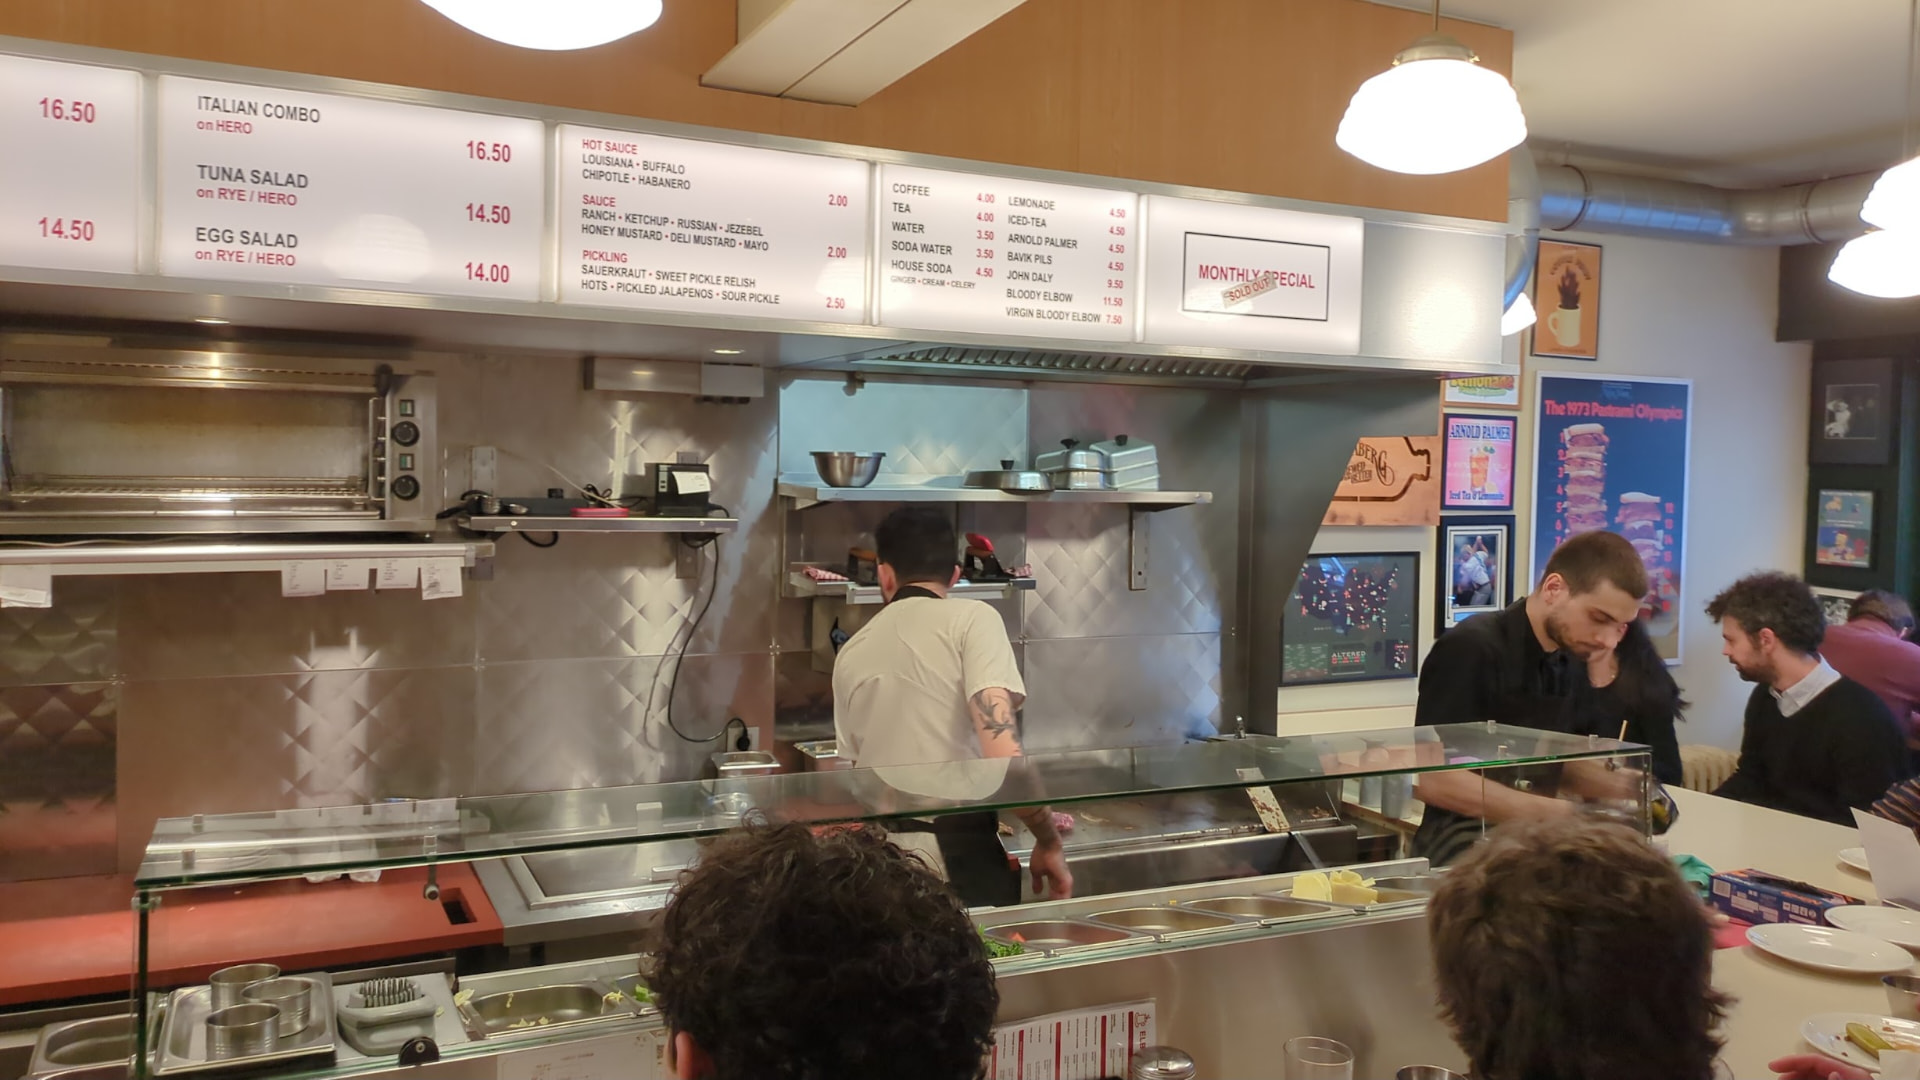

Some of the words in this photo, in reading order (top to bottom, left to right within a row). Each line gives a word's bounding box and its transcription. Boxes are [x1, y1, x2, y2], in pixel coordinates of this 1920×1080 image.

[40, 98, 95, 123] 16.50
[198, 96, 258, 116] ITALIAN
[263, 104, 320, 123] COMBO
[196, 121, 213, 130] on
[216, 120, 252, 134] HERO
[467, 141, 510, 162] 16.50
[582, 139, 603, 152] HOT
[605, 142, 637, 154] SAUCE
[583, 154, 634, 168] LOUISIANA
[642, 160, 685, 174] BUFFALO
[197, 165, 246, 182] TUNA
[250, 170, 308, 188] SALAD
[582, 169, 629, 183] CHIPOTLE
[638, 176, 690, 190] HABANERO
[893, 183, 929, 196] COFFEE
[196, 189, 214, 198] on
[218, 188, 246, 201] RYE
[258, 192, 297, 206] HERO
[582, 194, 616, 207] SAUCE
[829, 194, 848, 207] 2.00
[977, 193, 994, 204] 4.00
[1009, 197, 1054, 210] LEMONADE
[466, 203, 510, 224] 14.50
[893, 202, 911, 213] TEA
[1110, 208, 1126, 218] 4.50
[582, 209, 616, 221] RANCH
[625, 213, 669, 226] KETCHUP
[678, 218, 717, 231] RUSSIAN
[725, 224, 763, 236] JEZEBEL
[976, 212, 994, 222] 4.00
[1008, 215, 1046, 228] ICED-TEA
[39, 217, 94, 241] 14.50
[892, 222, 924, 233] WATER
[1109, 226, 1125, 236] 4.50
[196, 227, 234, 243] EGG
[240, 230, 298, 248] SALAD
[582, 224, 615, 236] HONEY
[618, 227, 662, 240] MUSTARD
[670, 232, 691, 243] DELI
[694, 234, 736, 248] MUSTARD
[744, 240, 768, 251] MAYO
[977, 230, 994, 240] 3.50
[1008, 234, 1042, 245] ARNOLD
[1045, 237, 1077, 248] PALMER
[828, 246, 846, 258] 2.00
[892, 240, 918, 252] SODA
[920, 244, 952, 255] WATER
[976, 248, 994, 259] 3.50
[1108, 244, 1124, 254] 4.50
[195, 251, 212, 260] on
[217, 250, 244, 262] RYE
[256, 253, 295, 266] HERO
[583, 250, 627, 263] PICKLING
[1008, 252, 1032, 262] BAVIK
[1034, 254, 1052, 264] PILS
[466, 262, 509, 283] 14.00
[892, 260, 924, 272] HOUSE
[926, 263, 952, 274] SODA
[976, 268, 993, 277] 4.50
[1108, 262, 1124, 271] 4.50
[1199, 264, 1260, 282] MONTHLY
[582, 264, 646, 278] SAUERKRAUT
[656, 270, 687, 282] SWEET
[690, 273, 721, 285] PICKLE
[724, 276, 755, 287] RELISH
[1007, 270, 1030, 280] JOHN
[1032, 272, 1053, 282] DALY
[951, 280, 976, 288] CELERY
[1108, 279, 1123, 289] 9.50
[1229, 285, 1251, 301] SOLD
[1252, 278, 1270, 292] OUT
[582, 280, 607, 291] HOTS
[616, 282, 656, 294] PICKLED
[659, 286, 713, 299] JALAPENOS
[722, 291, 747, 302] SOUR
[749, 293, 780, 304] PICKLE
[1007, 288, 1041, 300] BLOODY
[1043, 292, 1073, 302] ELBOW
[826, 297, 845, 309] 2.50
[1104, 297, 1123, 307] 11.50
[1006, 308, 1034, 318] VIRGIN
[1036, 309, 1070, 320] BLOODY
[1072, 312, 1100, 322] ELBOW
[1106, 314, 1122, 324] 7.50
[1544, 400, 1566, 415] The
[1568, 401, 1590, 416] 1973
[1592, 402, 1634, 418] Pastrami
[1636, 404, 1683, 422] Olympics
[1450, 424, 1481, 438] ARNOLD
[1482, 426, 1510, 439] PALMER
